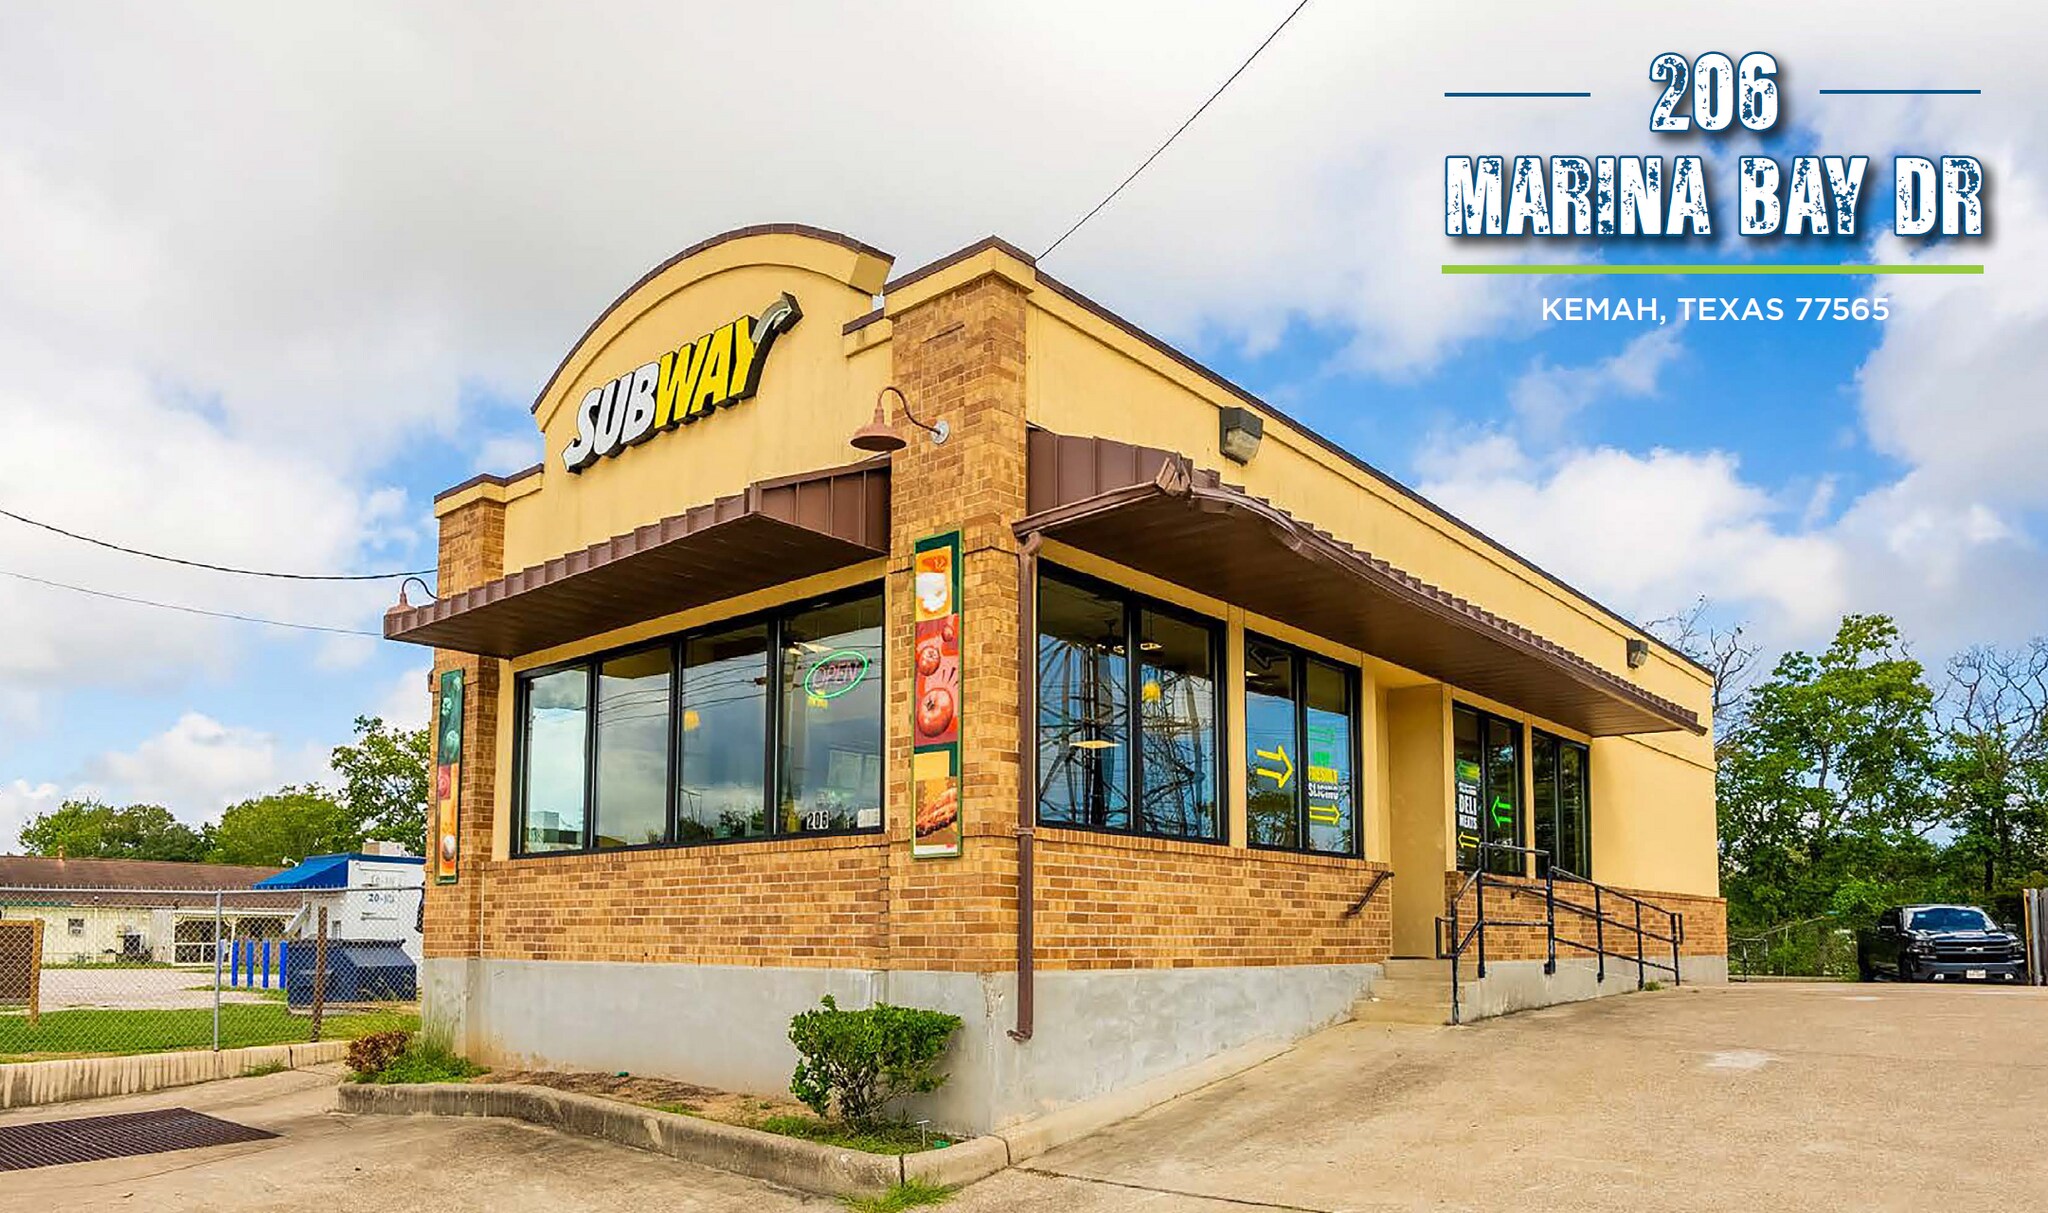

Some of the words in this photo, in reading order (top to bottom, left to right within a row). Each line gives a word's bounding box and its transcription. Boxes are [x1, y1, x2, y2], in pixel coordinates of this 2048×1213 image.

[561, 290, 803, 474] SUBWAY
[812, 658, 859, 688] OPEN
[1458, 793, 1478, 816] DELI
[806, 810, 829, 830] 206
